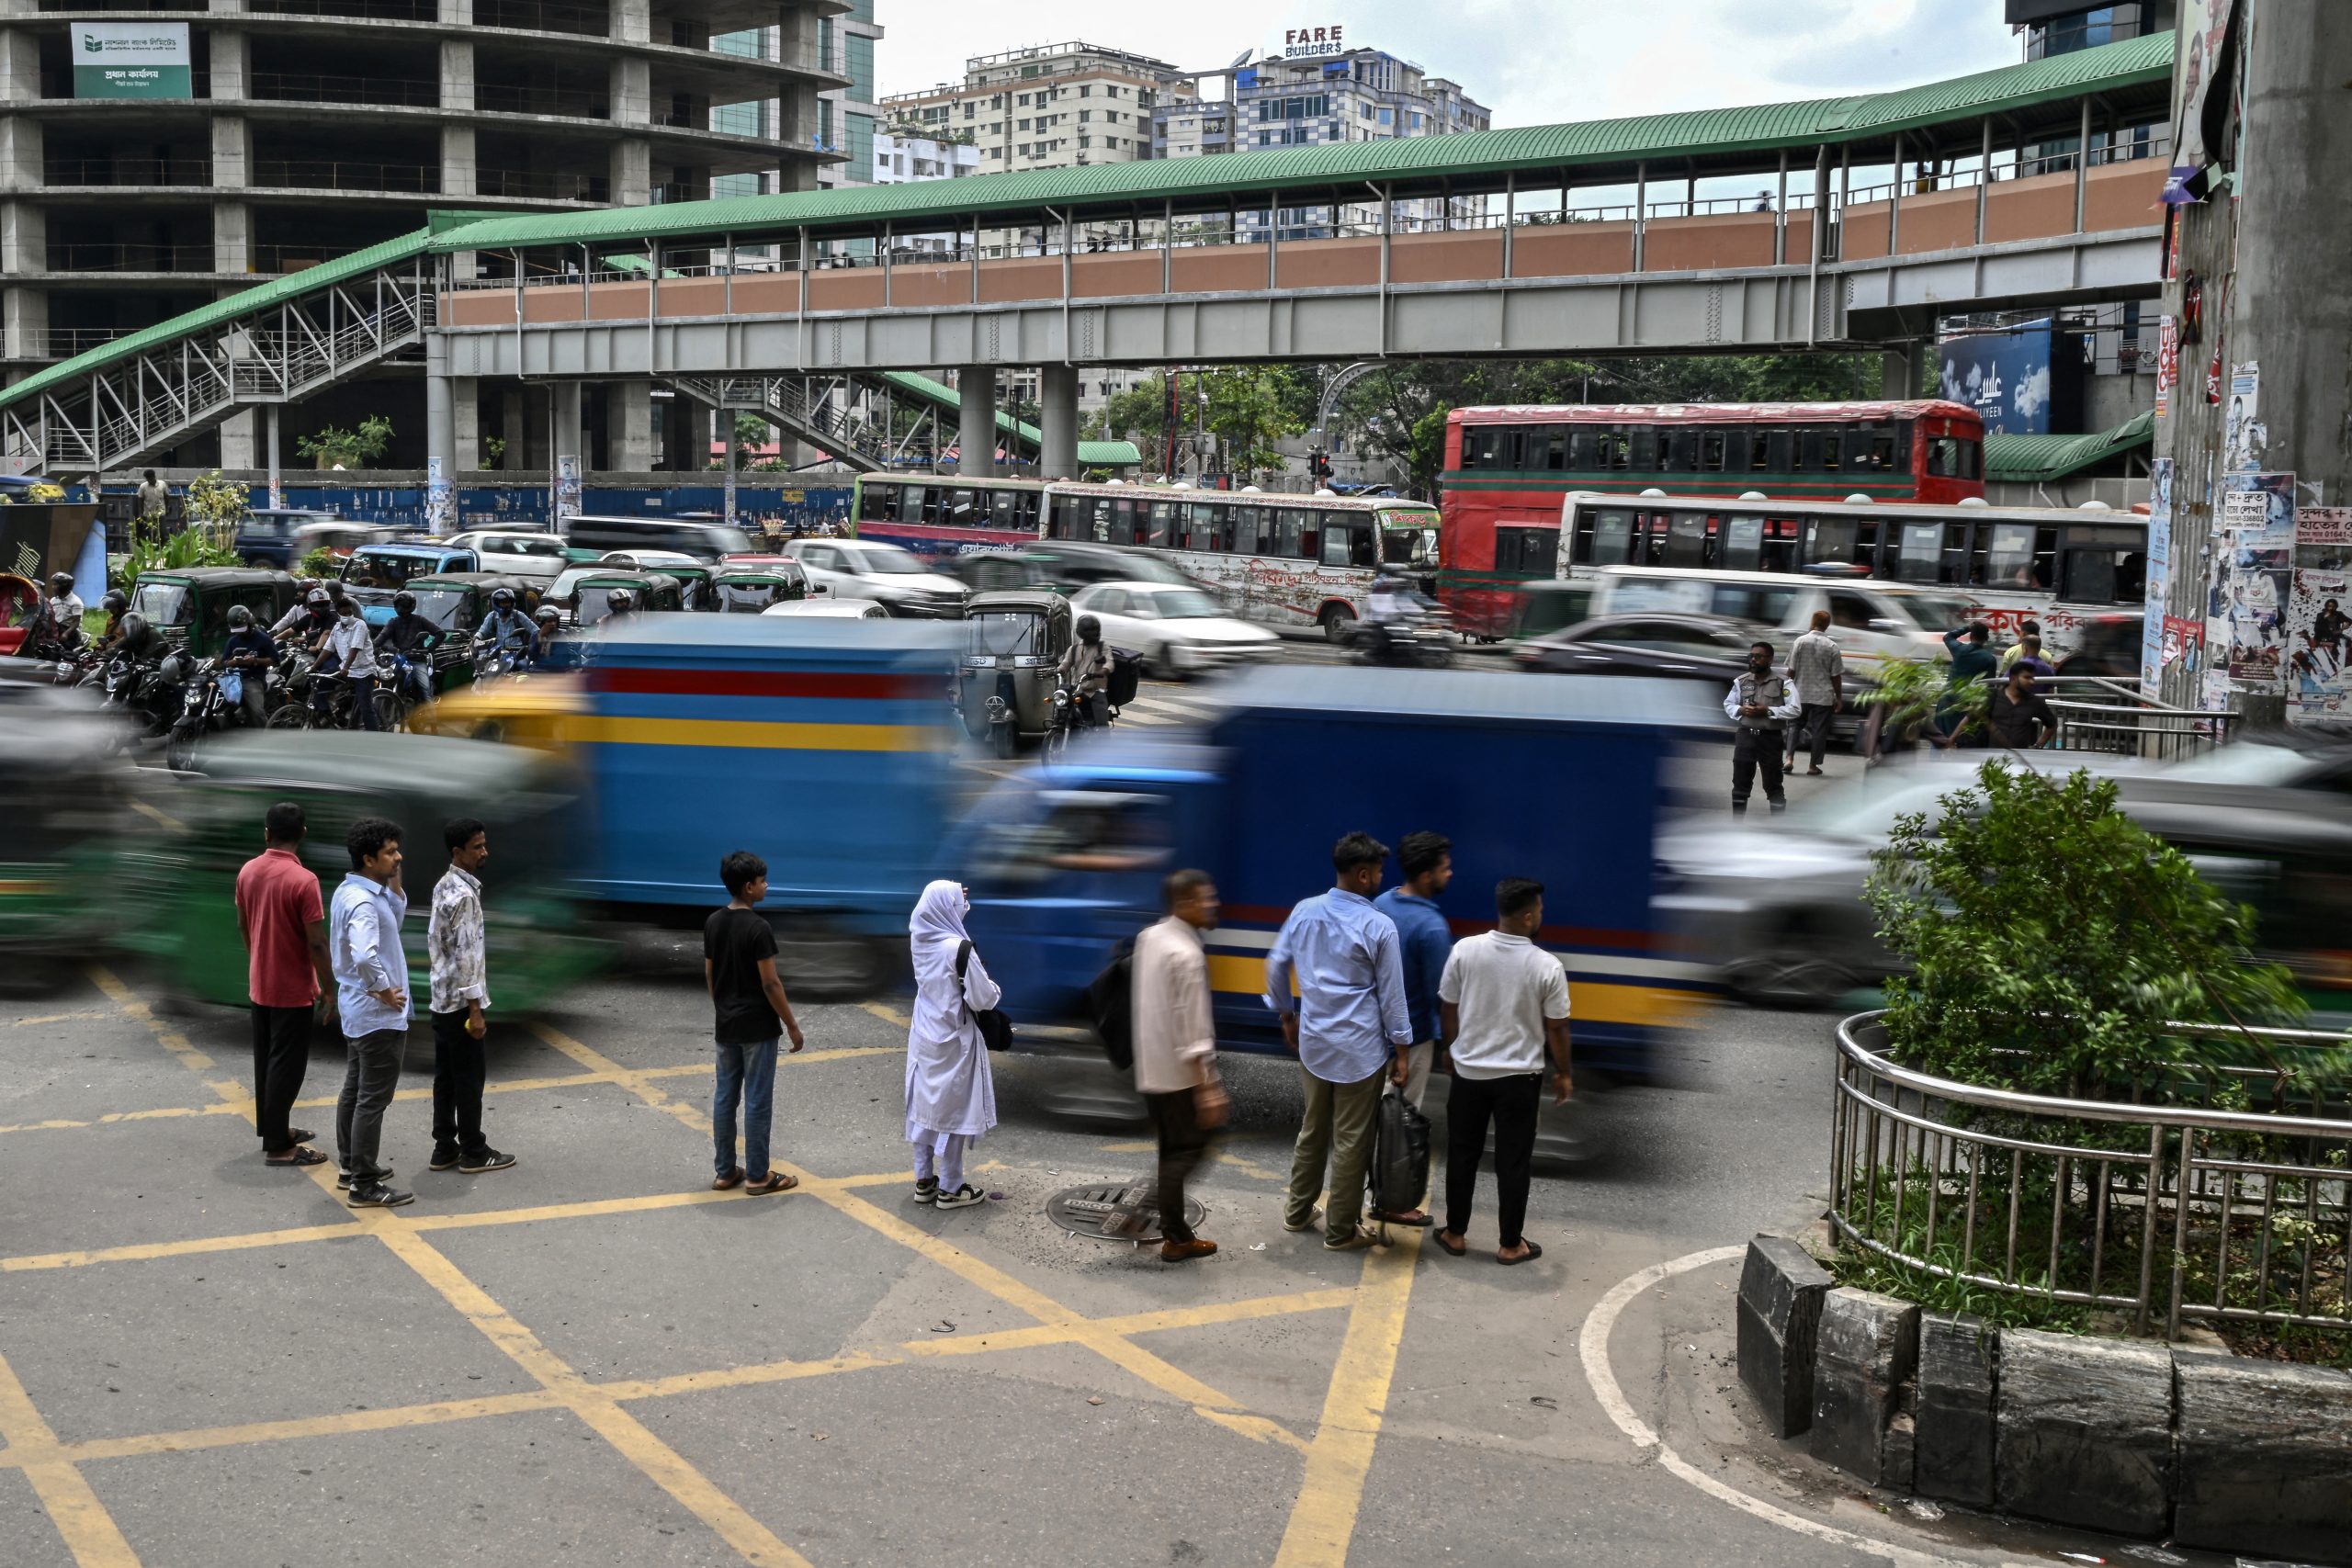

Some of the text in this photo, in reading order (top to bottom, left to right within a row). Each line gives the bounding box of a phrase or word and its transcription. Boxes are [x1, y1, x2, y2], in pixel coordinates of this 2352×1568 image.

[1285, 26, 1342, 45] FARE
[150, 38, 176, 47] লিমিটেড
[1285, 41, 1342, 58] BUILDERS
[105, 69, 158, 79] প্রধান কার্যালয়
[2157, 325, 2171, 392] UCC
[1974, 406, 2003, 419] LIYEEN
[2244, 493, 2265, 503] দ্রুত
[2240, 505, 2265, 514] লেখা
[2299, 508, 2331, 519] সুন্দর
[2298, 521, 2341, 530] হাতের
[2043, 610, 2087, 631] পরিব
